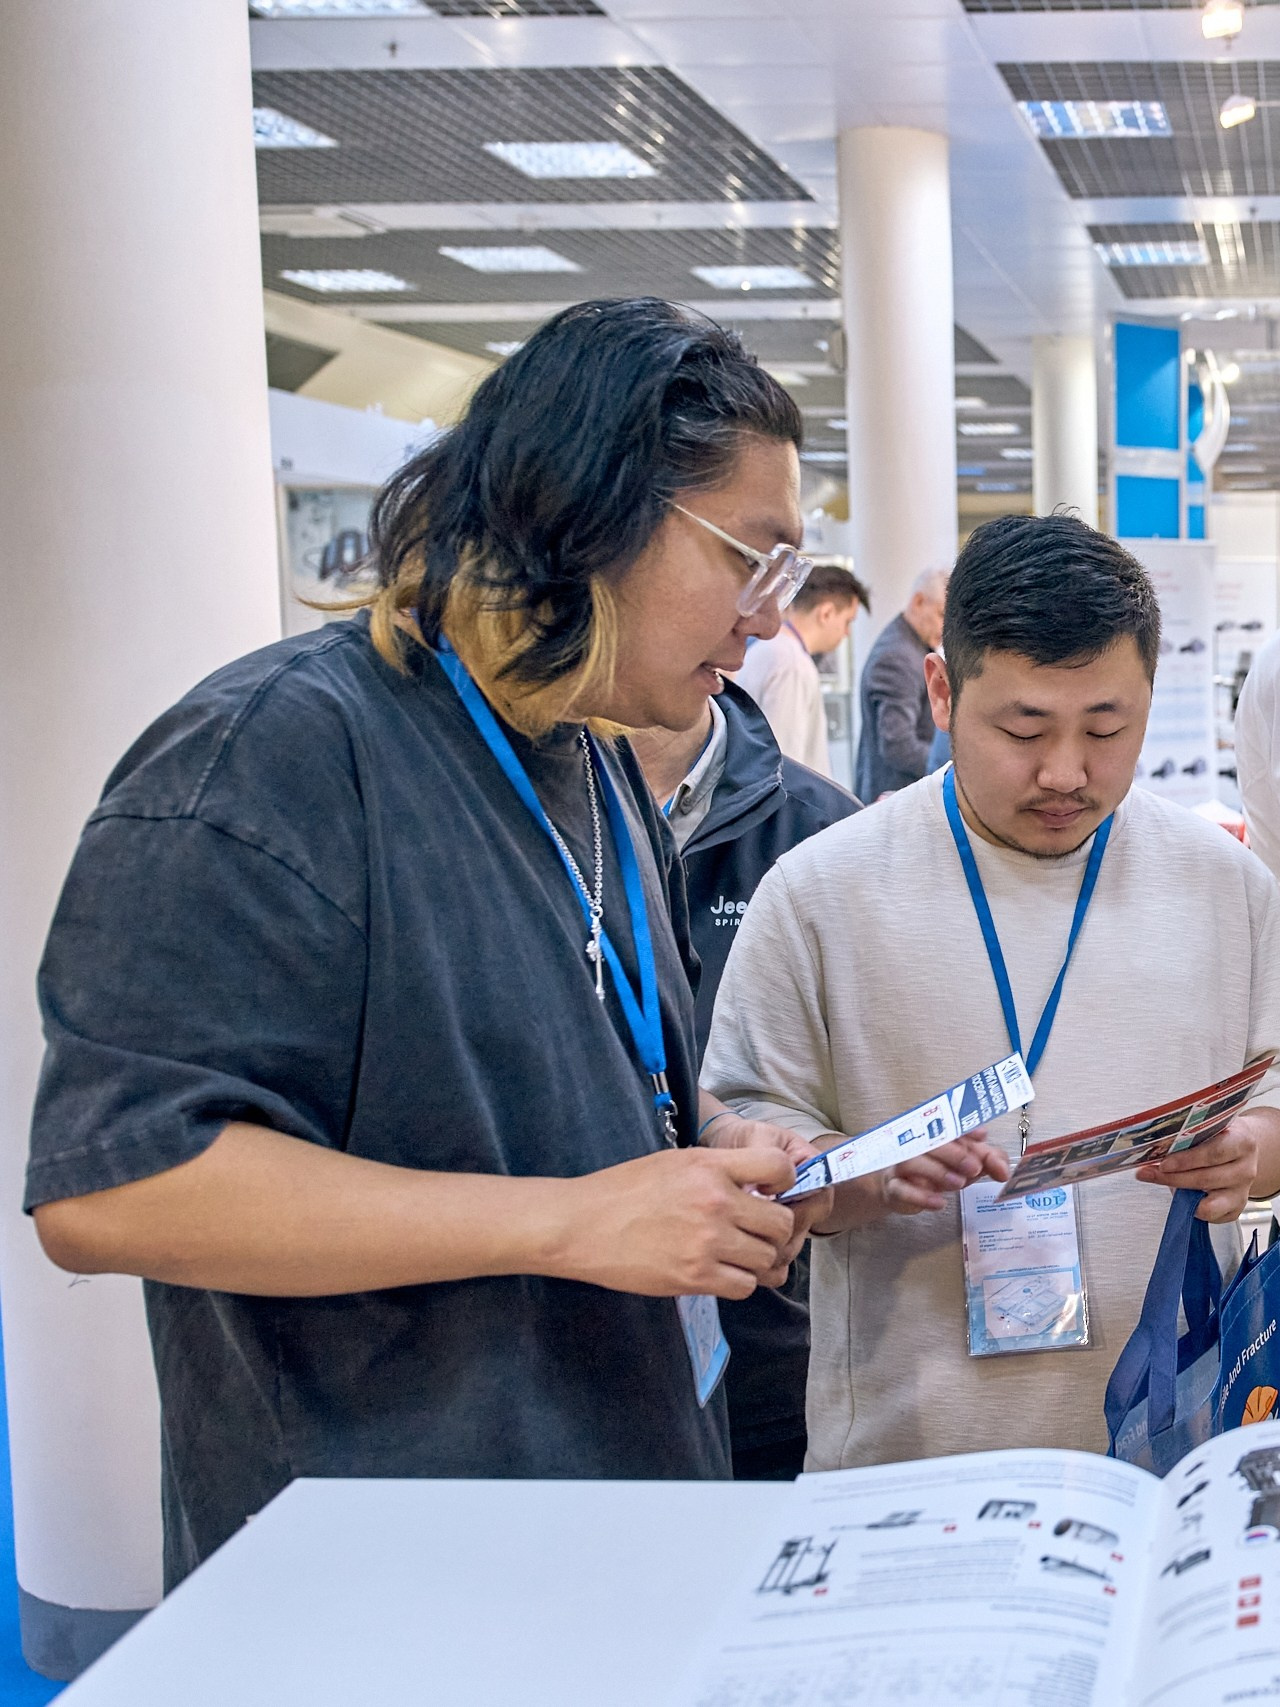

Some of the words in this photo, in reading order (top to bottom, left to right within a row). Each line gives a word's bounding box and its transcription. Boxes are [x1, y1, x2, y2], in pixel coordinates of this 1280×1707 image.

[710, 895, 748, 914] Jee
[715, 918, 740, 926] SPIR
[1031, 1195, 1061, 1208] NDT
[1229, 1356, 1241, 1389] And
[1241, 1319, 1277, 1366] Fracture
